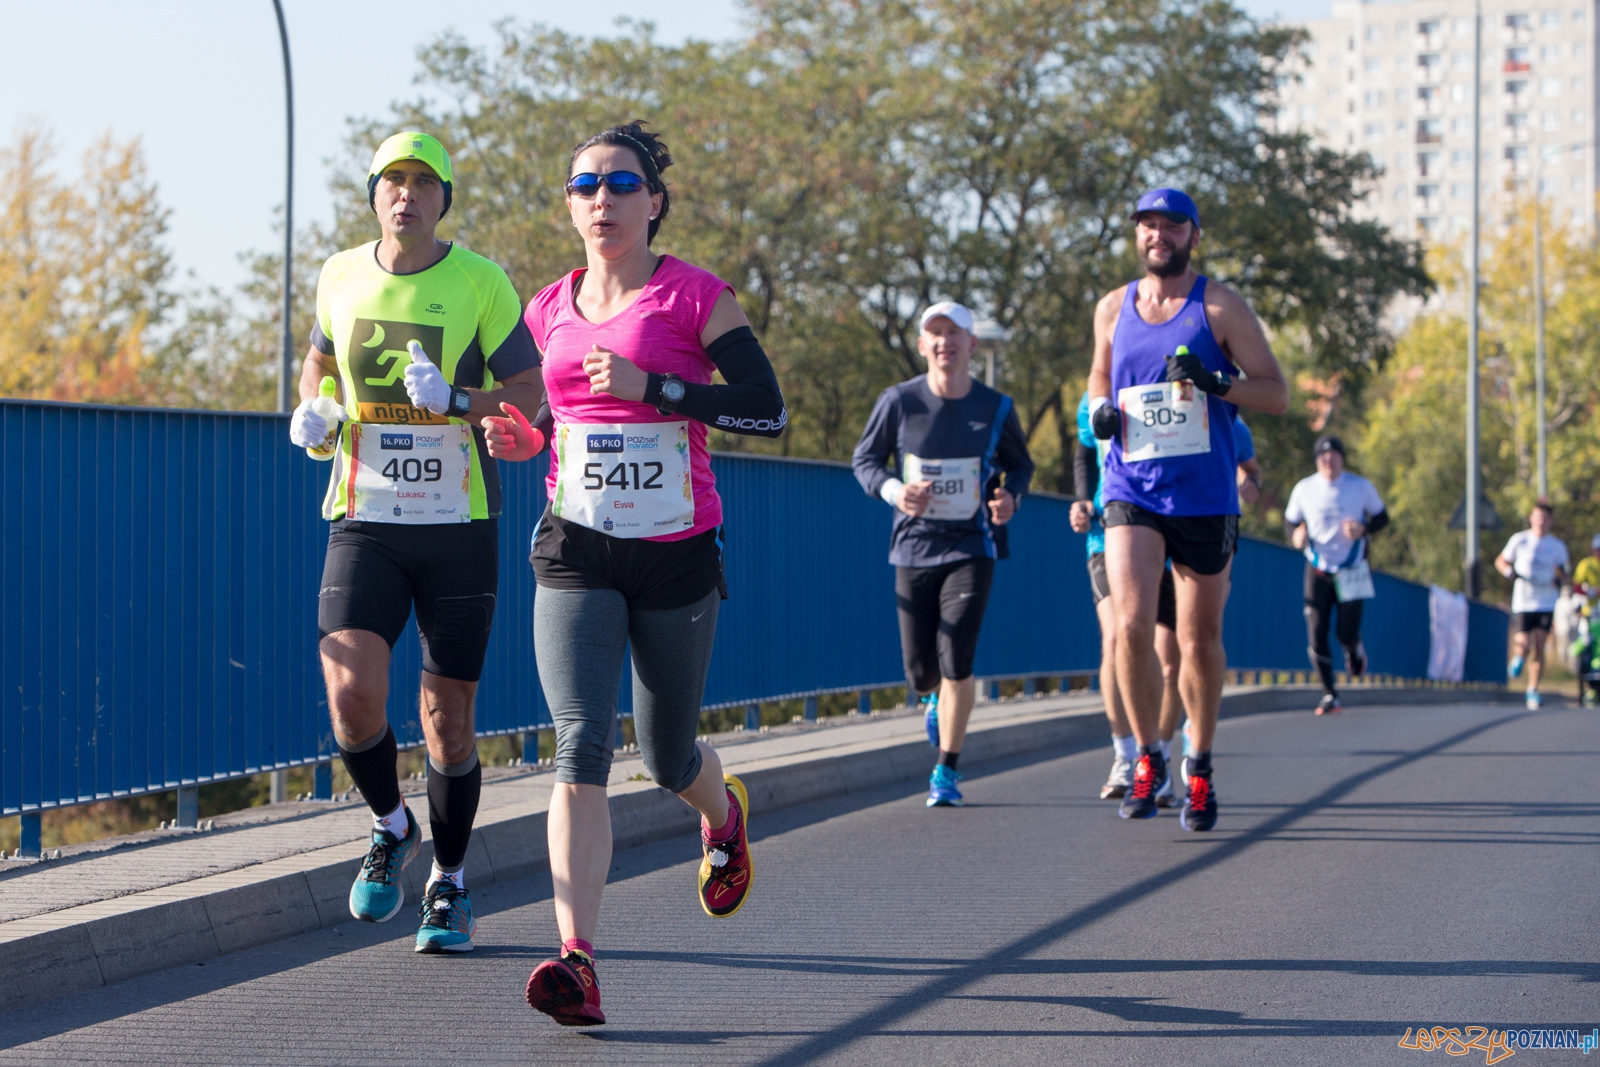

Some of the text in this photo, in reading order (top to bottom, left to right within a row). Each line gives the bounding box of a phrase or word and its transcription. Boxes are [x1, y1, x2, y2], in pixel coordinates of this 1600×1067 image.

[375, 404, 432, 423] night
[716, 407, 788, 431] BROOKS
[1143, 408, 1187, 427] 805
[382, 458, 442, 482] 409
[584, 462, 663, 490] 5412
[396, 490, 426, 499] Łukasz
[921, 479, 964, 495] 681
[614, 501, 634, 509] Ewa
